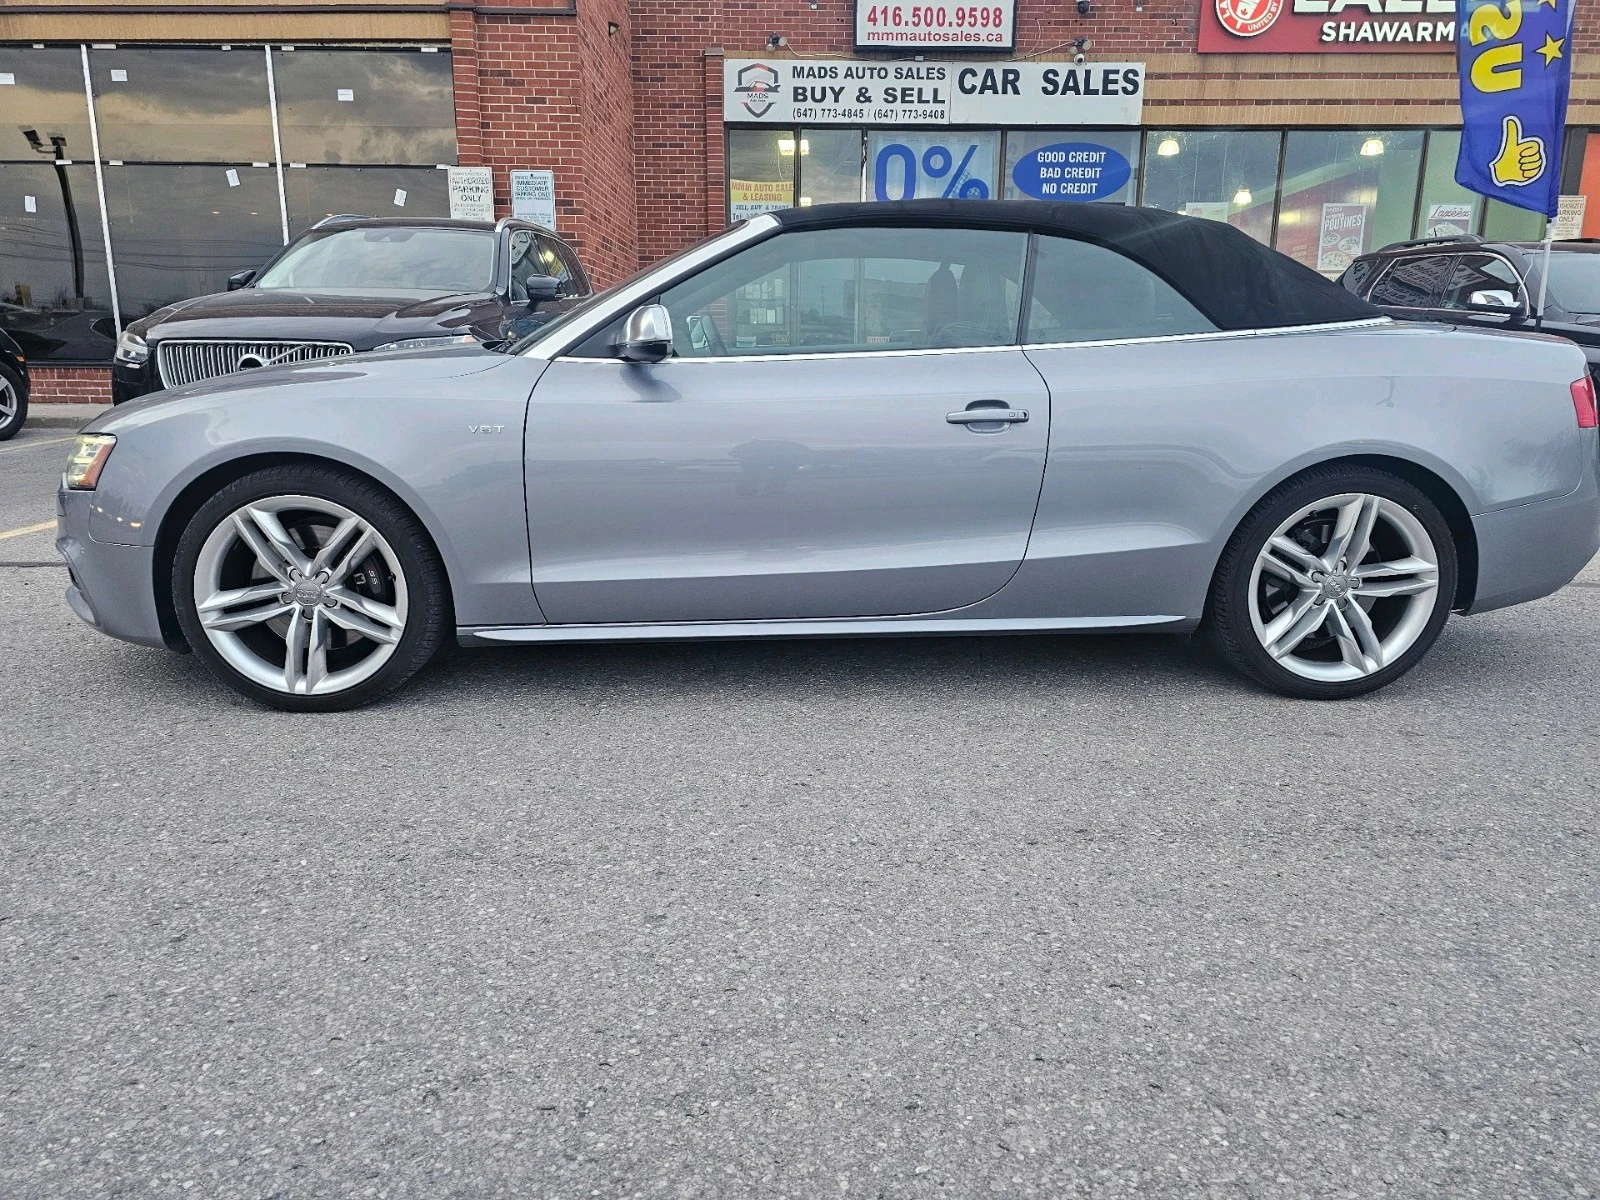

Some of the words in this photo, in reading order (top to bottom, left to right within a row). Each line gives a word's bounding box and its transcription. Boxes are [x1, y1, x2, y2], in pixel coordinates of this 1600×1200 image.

[867, 5, 1003, 28] 416.500.9598
[1247, 12, 1273, 31] UNITED
[1270, 1, 1279, 12] BY
[867, 30, 1003, 42] mmmautosales.ca
[792, 65, 839, 79] MADS
[844, 66, 889, 80] AUTO
[893, 66, 946, 80] SALES
[958, 67, 1021, 95] CAR
[1041, 68, 1140, 96] SALES
[792, 86, 846, 103] BUY
[855, 86, 873, 104] &
[882, 87, 946, 104] SELL
[792, 107, 817, 119] (647)
[821, 107, 864, 119] 773-4845
[873, 108, 898, 120] (647)
[901, 108, 945, 119] 773-9408
[1037, 151, 1066, 163] GOOD
[1068, 151, 1107, 163] CREDIT
[875, 143, 990, 201] 0%
[1040, 167, 1061, 178] BAD
[1064, 167, 1102, 178] CREDIT
[453, 185, 490, 193] PARKING
[731, 181, 752, 192] MMM
[754, 183, 774, 192] AUTO
[1042, 182, 1057, 194] NO
[1060, 182, 1098, 194] CREDIT
[460, 194, 482, 202] ONLY
[742, 193, 749, 201] &
[750, 193, 782, 202] LEASING
[1324, 214, 1362, 232] POUTINES
